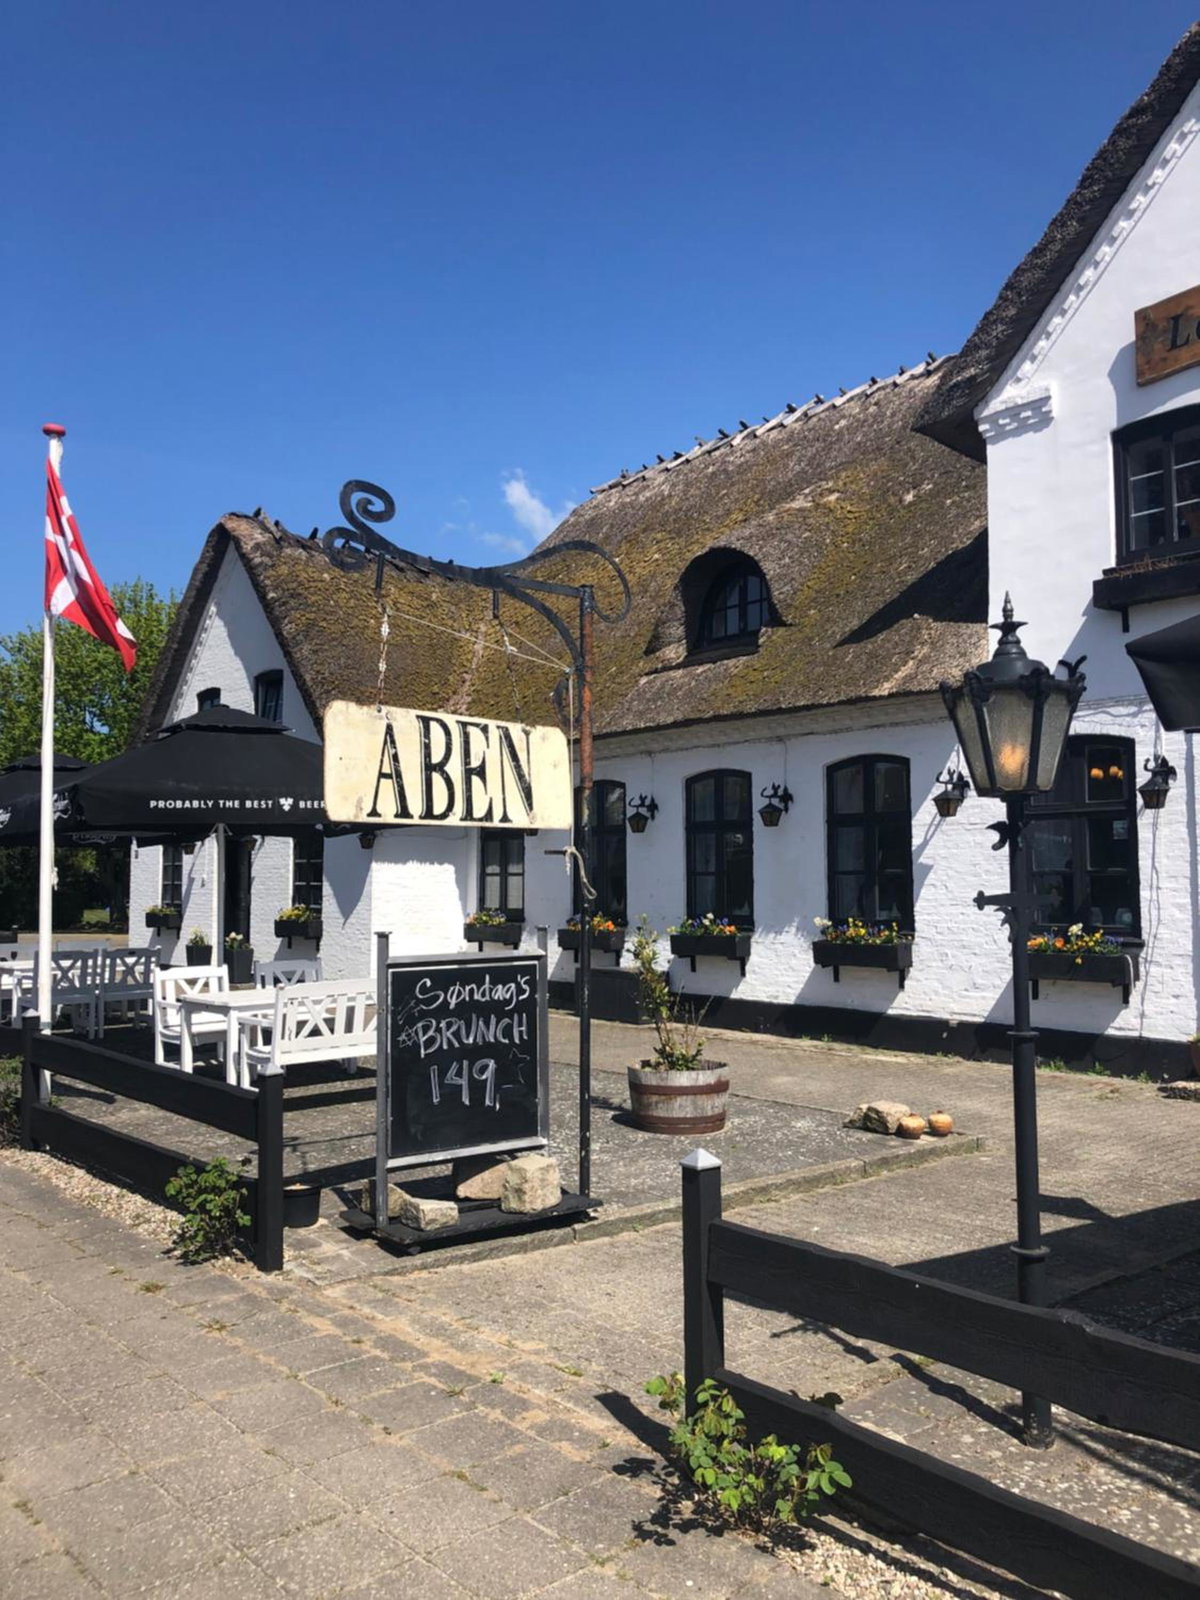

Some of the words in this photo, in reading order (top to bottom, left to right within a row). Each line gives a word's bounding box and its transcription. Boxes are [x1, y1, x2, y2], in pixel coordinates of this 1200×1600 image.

[149, 799, 214, 809] PROBABLY
[218, 799, 240, 809] THE
[245, 799, 273, 809] BEST
[417, 1012, 528, 1058] BRUNCH
